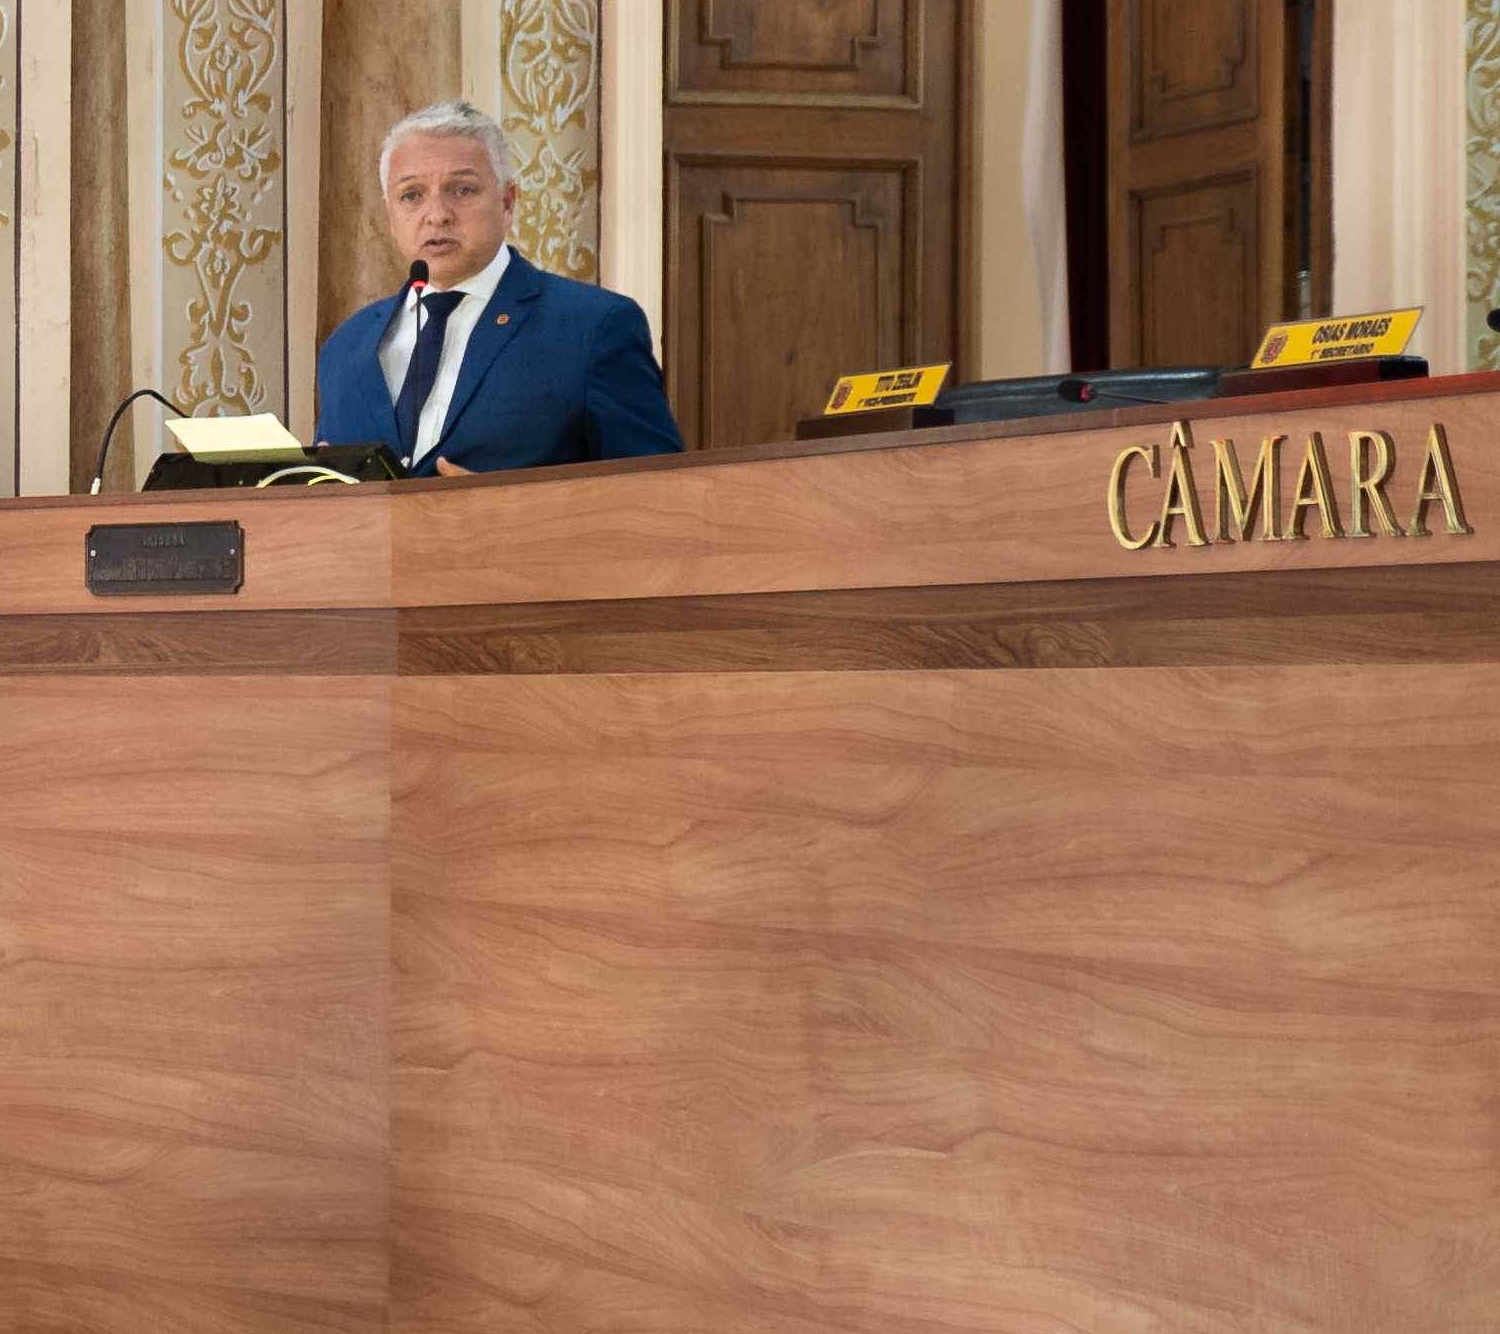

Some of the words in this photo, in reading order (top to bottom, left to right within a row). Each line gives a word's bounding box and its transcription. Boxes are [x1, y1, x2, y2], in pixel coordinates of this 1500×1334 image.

[1312, 322, 1348, 344] OSIAS
[1344, 317, 1393, 341] MORAES
[1107, 418, 1475, 550] CÂMARA
